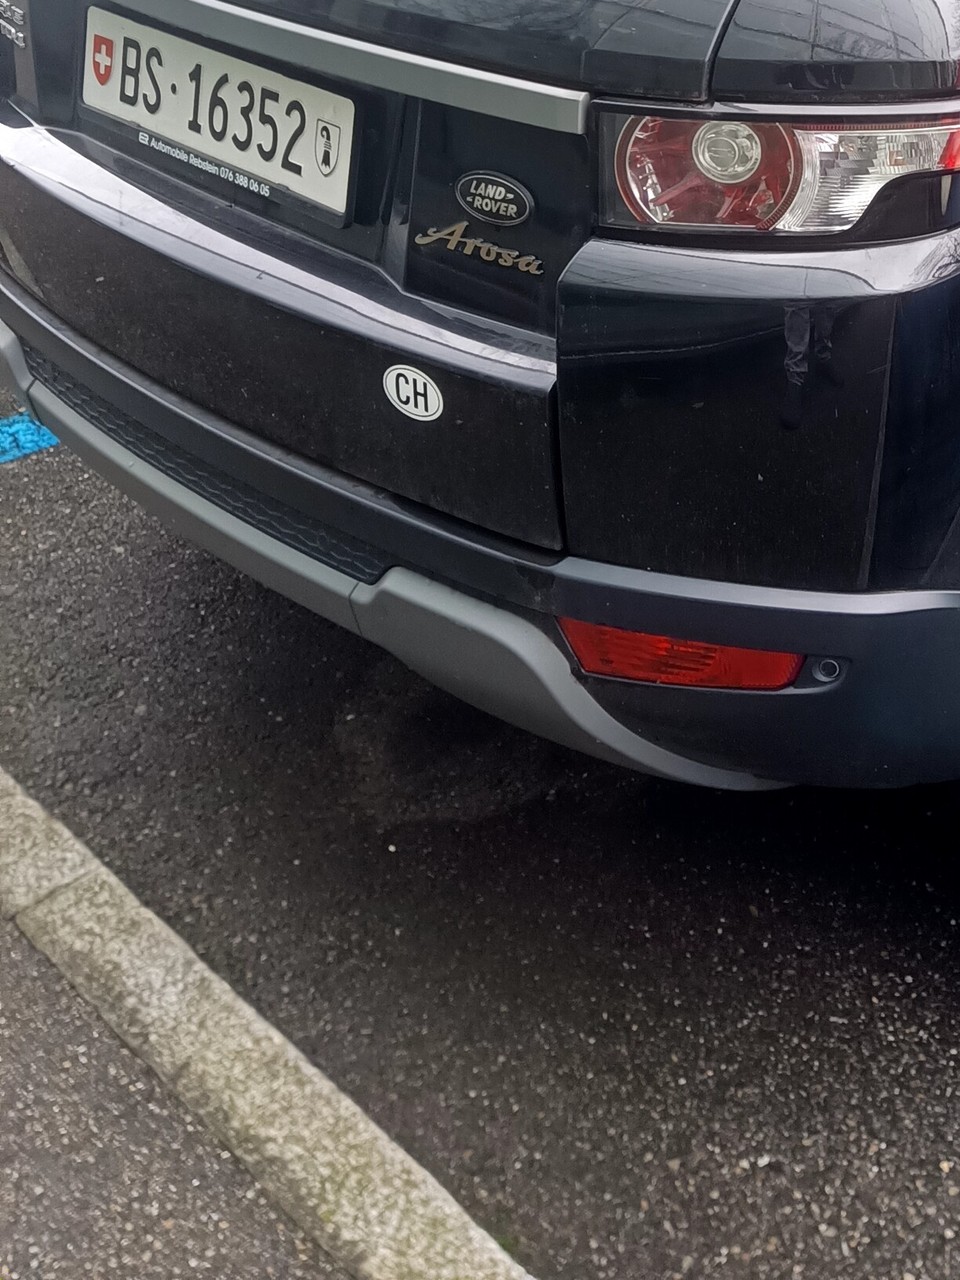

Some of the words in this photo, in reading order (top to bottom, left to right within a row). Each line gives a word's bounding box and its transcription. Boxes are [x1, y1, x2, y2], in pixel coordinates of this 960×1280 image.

[150, 135, 189, 162] Automobile
[189, 154, 219, 174] Rebstein
[219, 166, 233, 182] 076
[234, 173, 249, 188] 388
[249, 179, 259, 193] 06
[260, 183, 270, 197] 05
[415, 221, 543, 275] Arosa
[395, 372, 428, 413] CH
